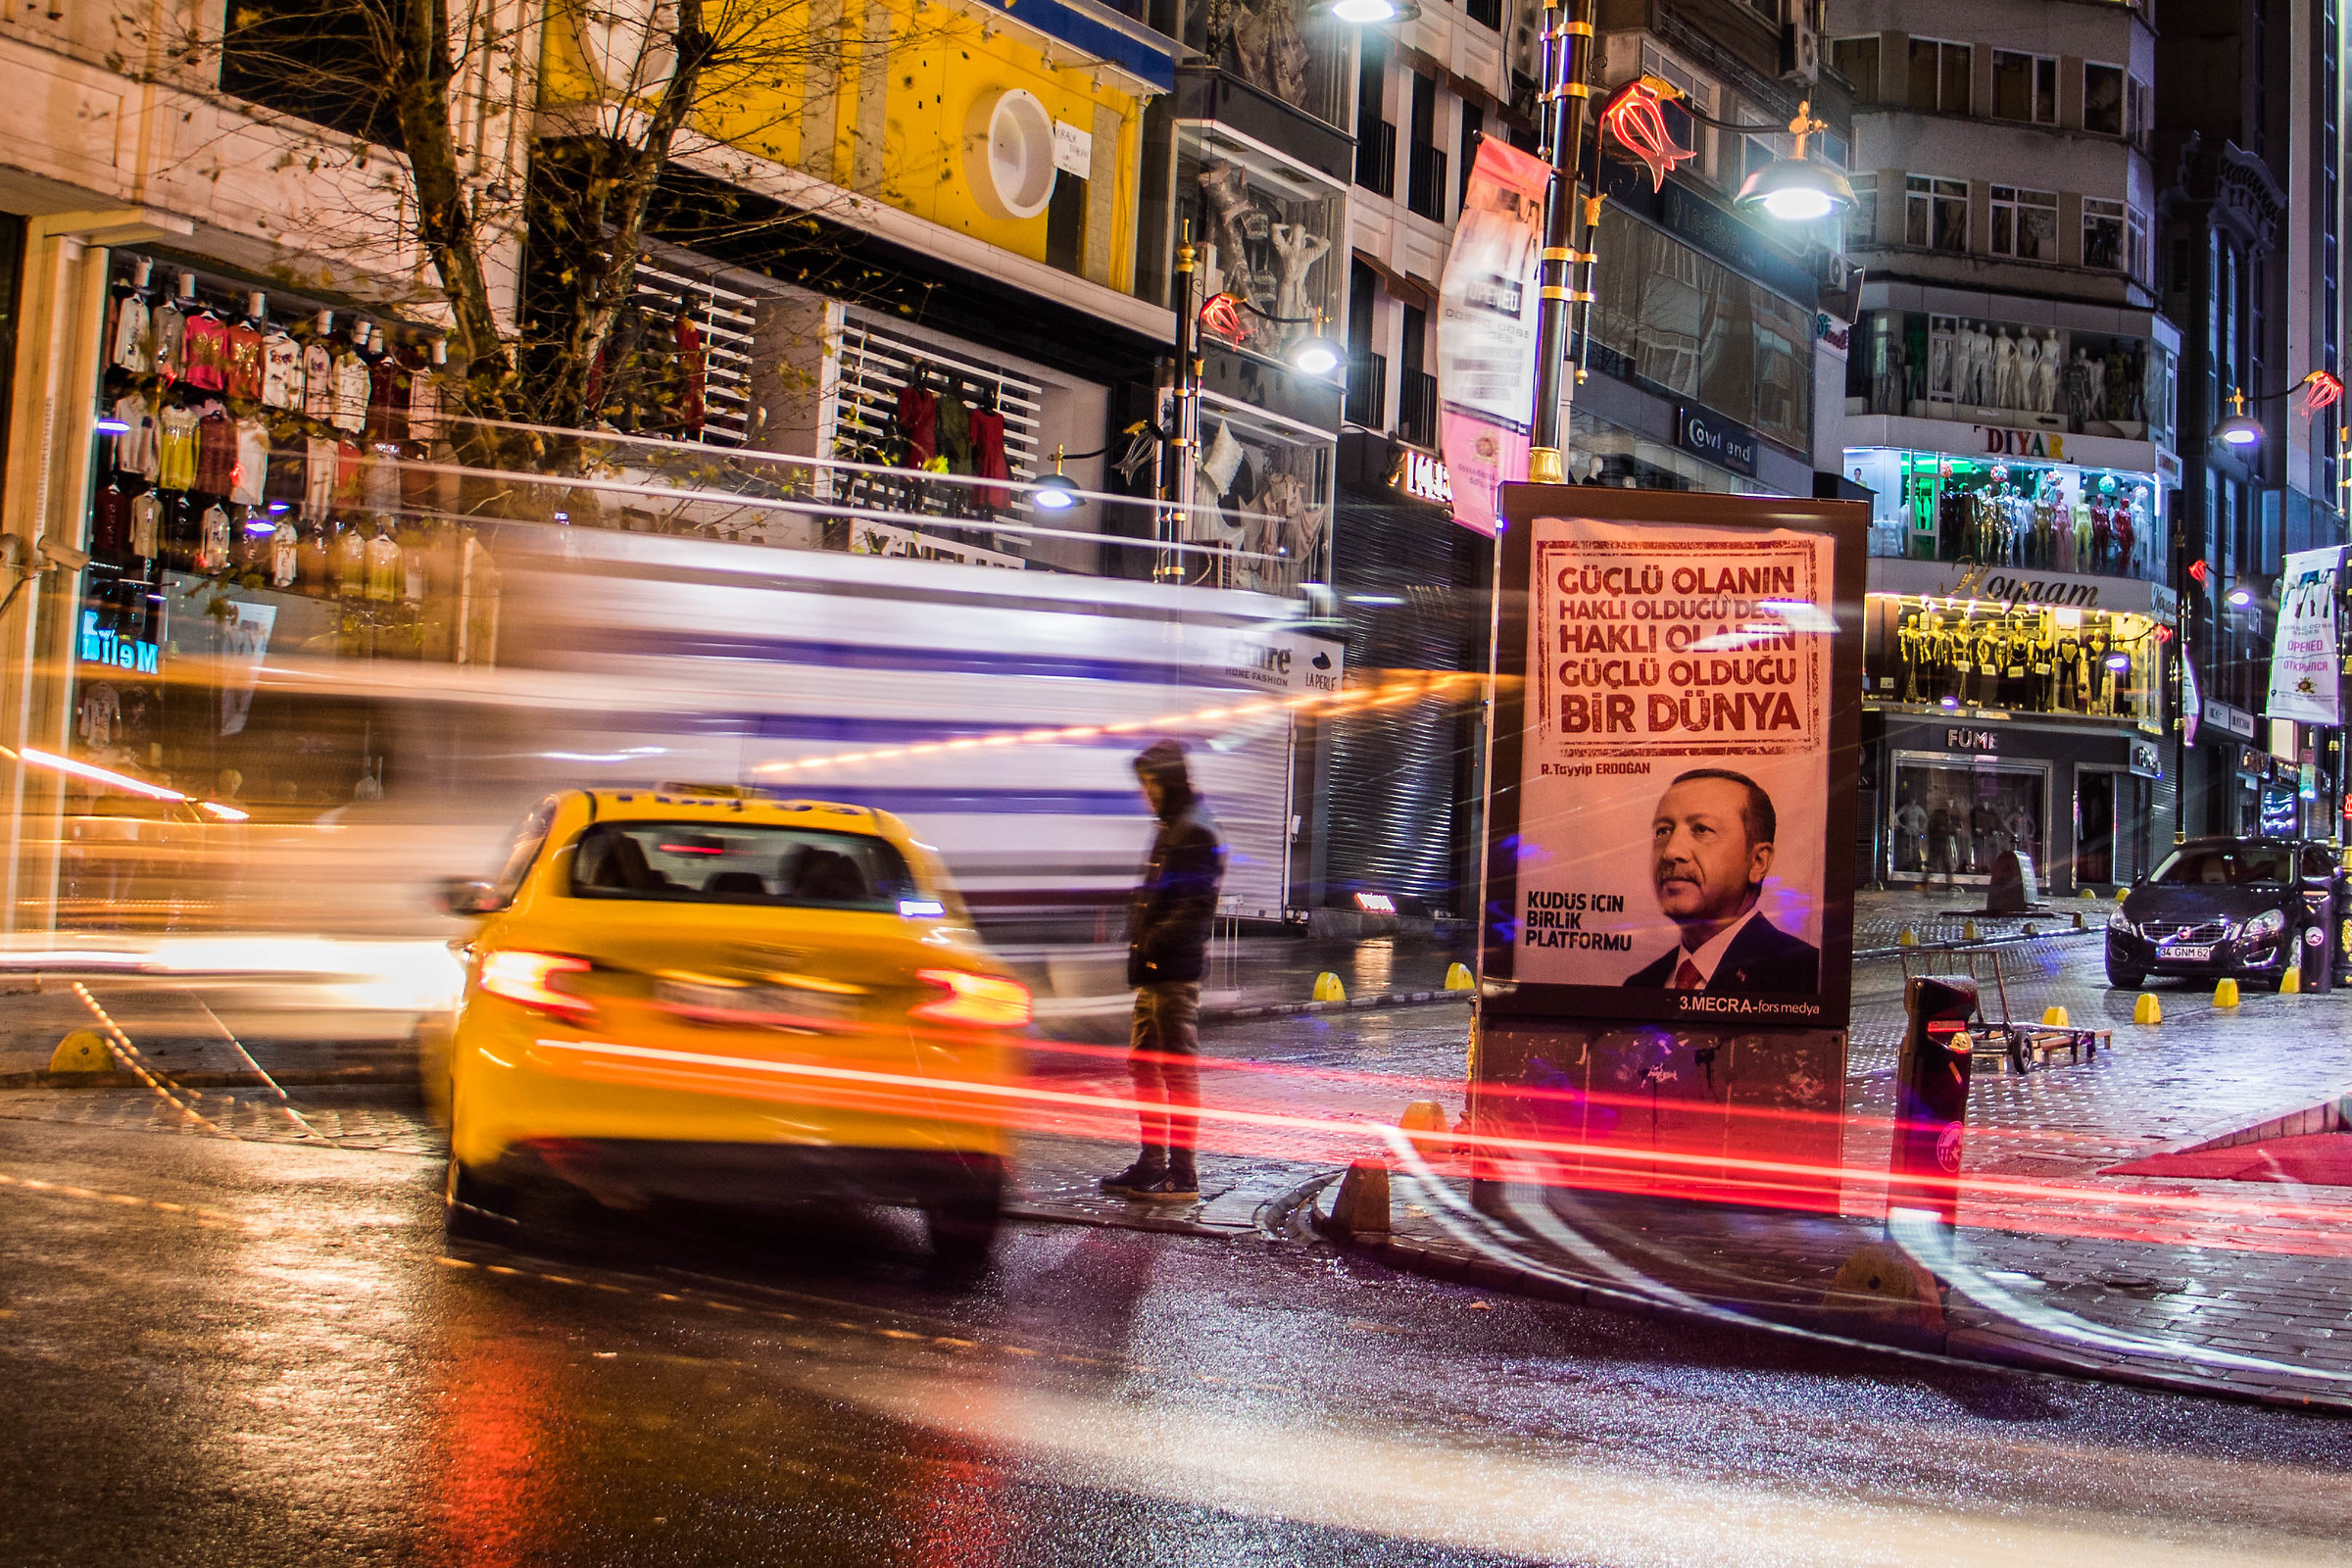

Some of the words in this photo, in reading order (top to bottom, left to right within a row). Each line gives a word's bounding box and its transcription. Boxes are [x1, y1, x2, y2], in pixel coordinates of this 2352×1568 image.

[1469, 280, 1517, 311] OPENED
[1984, 427, 2065, 461] DIYAR
[1557, 565, 1664, 597] GÜÇLÜ
[1672, 565, 1794, 594] OLANIN
[1559, 600, 1626, 620] HAKLI
[1632, 598, 1728, 620] OLDUĞU
[1559, 624, 1656, 653] HAKLI
[2287, 640, 2324, 653] OPENED
[1559, 658, 1659, 689] GÜÇLÜ
[1668, 655, 1796, 687] OLDUĞU
[2283, 660, 2328, 672] ОТКРЫЛСЯ
[1225, 668, 1250, 679] HOME
[1252, 672, 1289, 687] FASHION
[1647, 689, 1800, 732] DÜNYA
[1947, 727, 1998, 750] FÜME
[1596, 761, 1650, 774] ERDOĞAN
[1528, 891, 1587, 910] KUDÜS
[1526, 929, 1632, 952] PLATFORMU
[2160, 948, 2172, 956] 34
[2175, 948, 2195, 957] GNM
[2197, 948, 2209, 957] 62
[1781, 1002, 1820, 1015] medya
